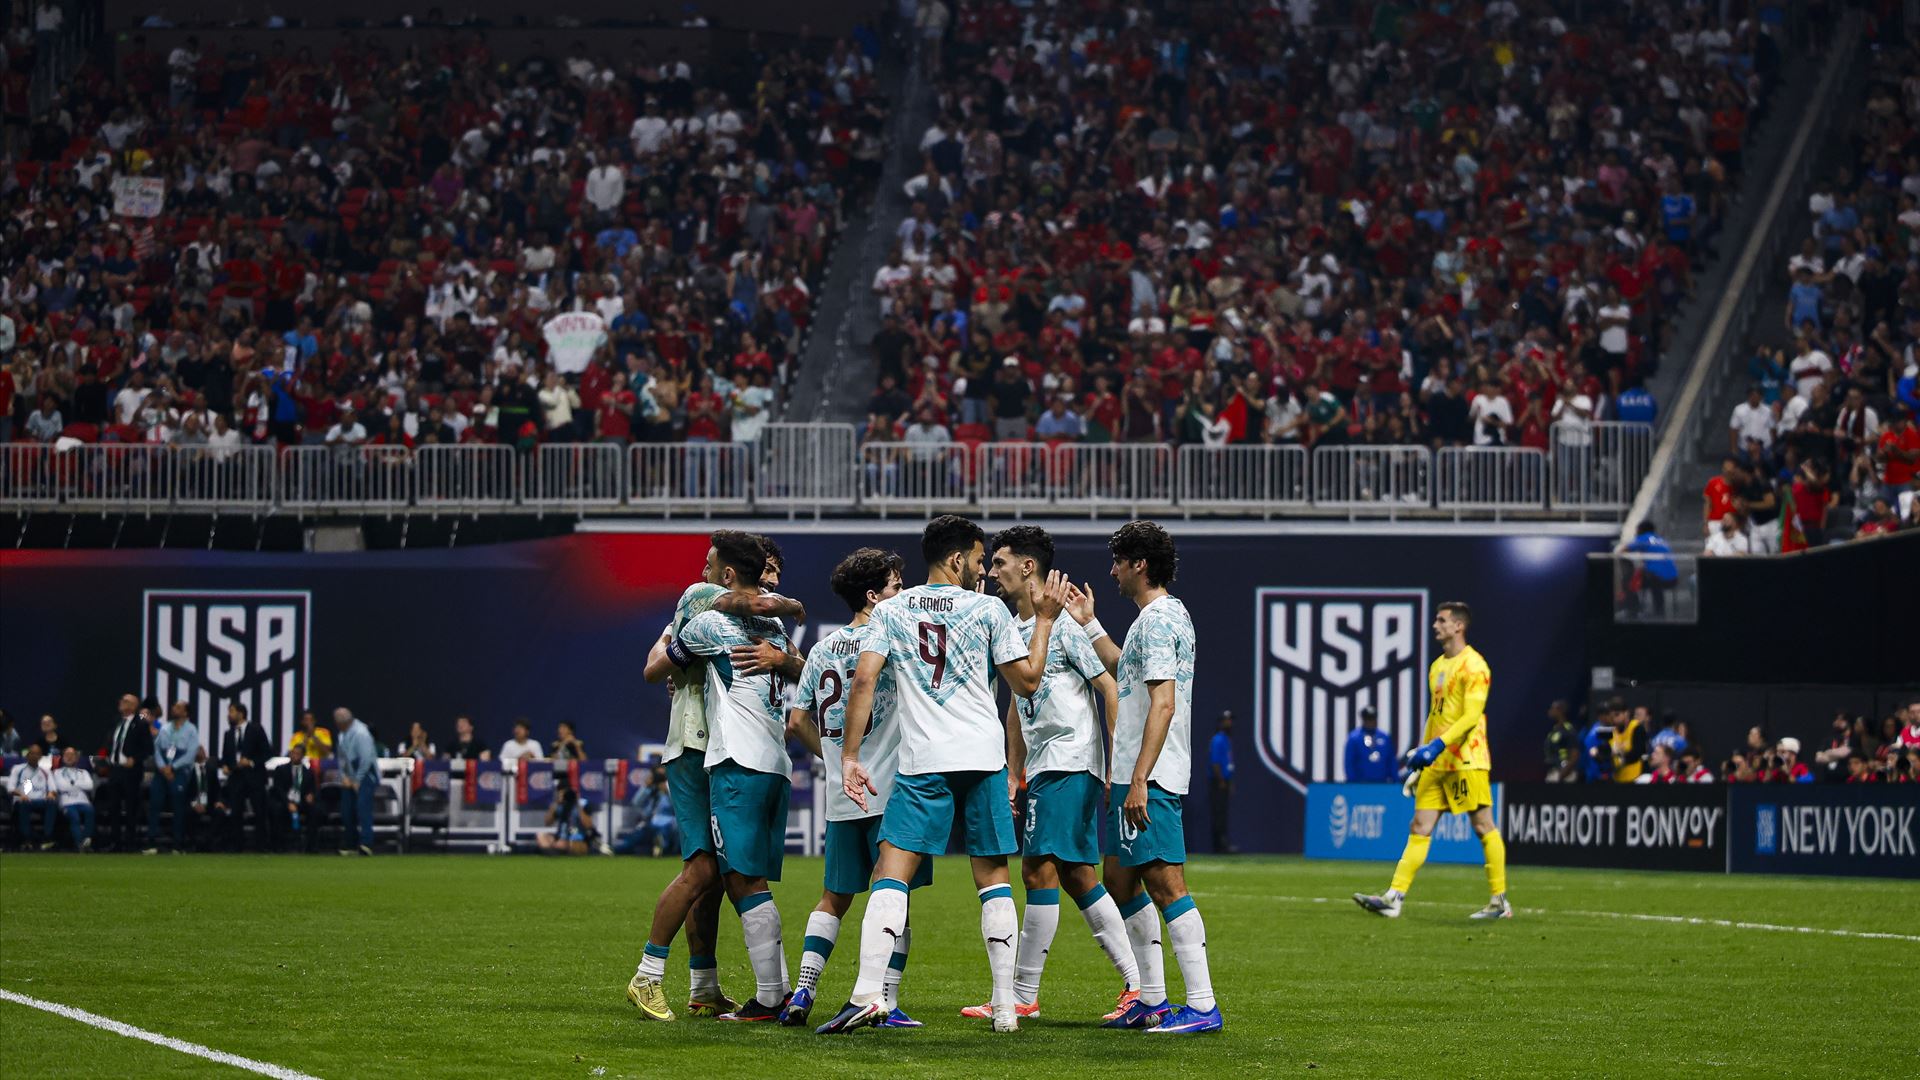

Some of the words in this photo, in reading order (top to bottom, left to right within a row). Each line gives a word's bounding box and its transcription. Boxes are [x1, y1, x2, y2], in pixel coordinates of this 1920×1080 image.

[919, 597, 954, 612] RAMOS
[157, 605, 296, 688] USA
[918, 622, 947, 689] 9
[1270, 603, 1413, 687] USA
[1452, 778, 1469, 801] 24
[711, 815, 724, 849] 8
[1350, 805, 1386, 839] AT&T
[1508, 804, 1619, 846] MARRIOTT
[1781, 806, 1840, 855] NEW
[1844, 805, 1917, 856] YORK
